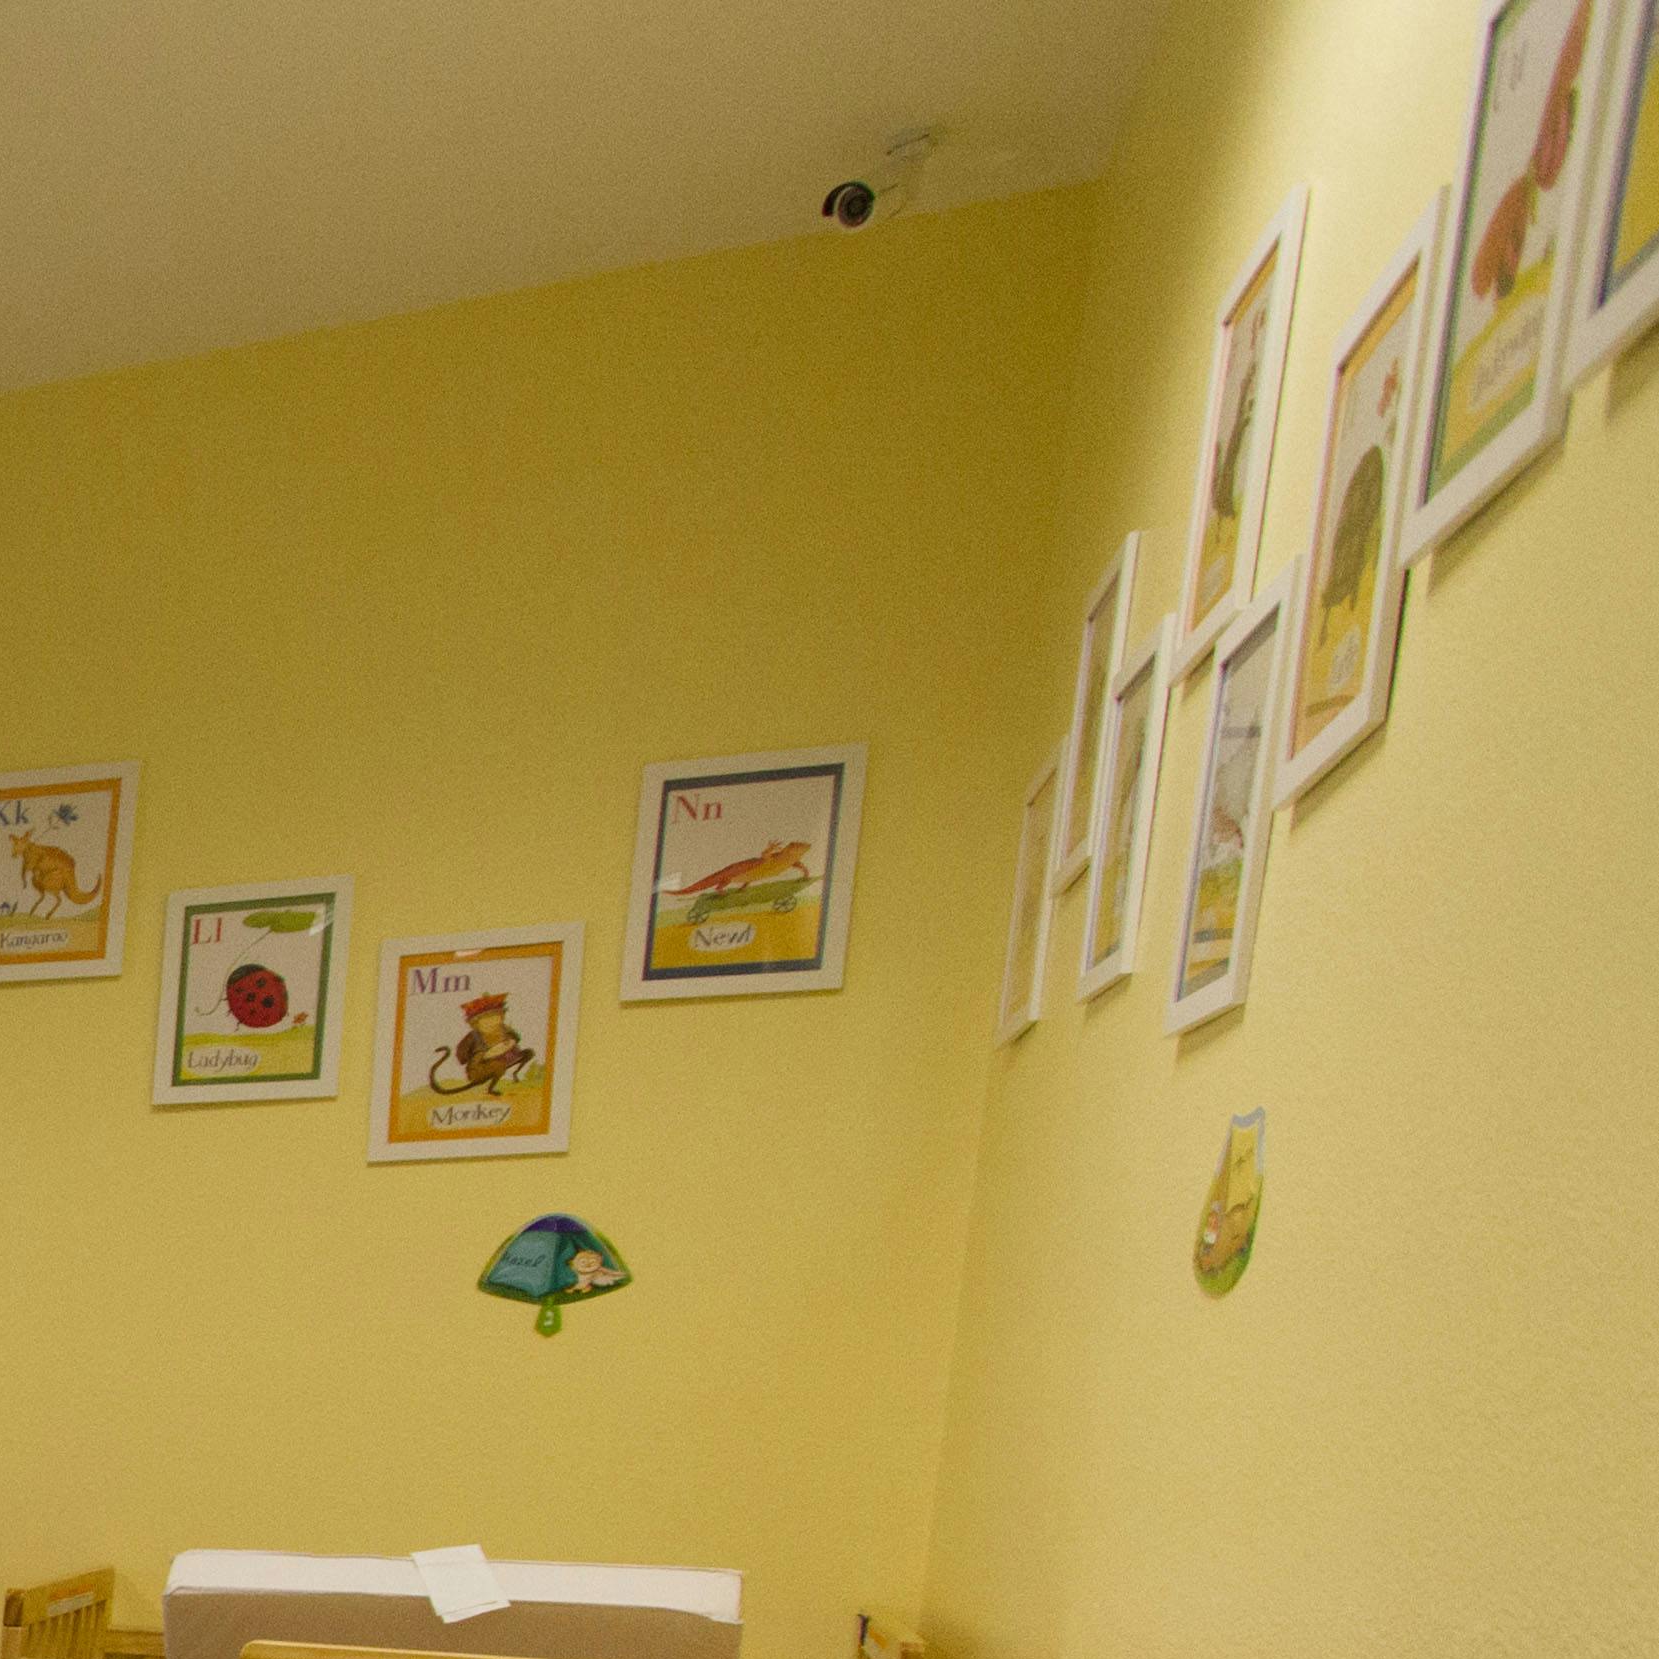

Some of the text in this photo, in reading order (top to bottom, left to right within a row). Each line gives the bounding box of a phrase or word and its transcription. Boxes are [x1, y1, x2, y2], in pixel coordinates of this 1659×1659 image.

[670, 793, 723, 824] Nn
[191, 916, 223, 945] Ll
[413, 967, 471, 995] Mm
[188, 1048, 258, 1073] Ladybug
[431, 1103, 512, 1125] Monkey
